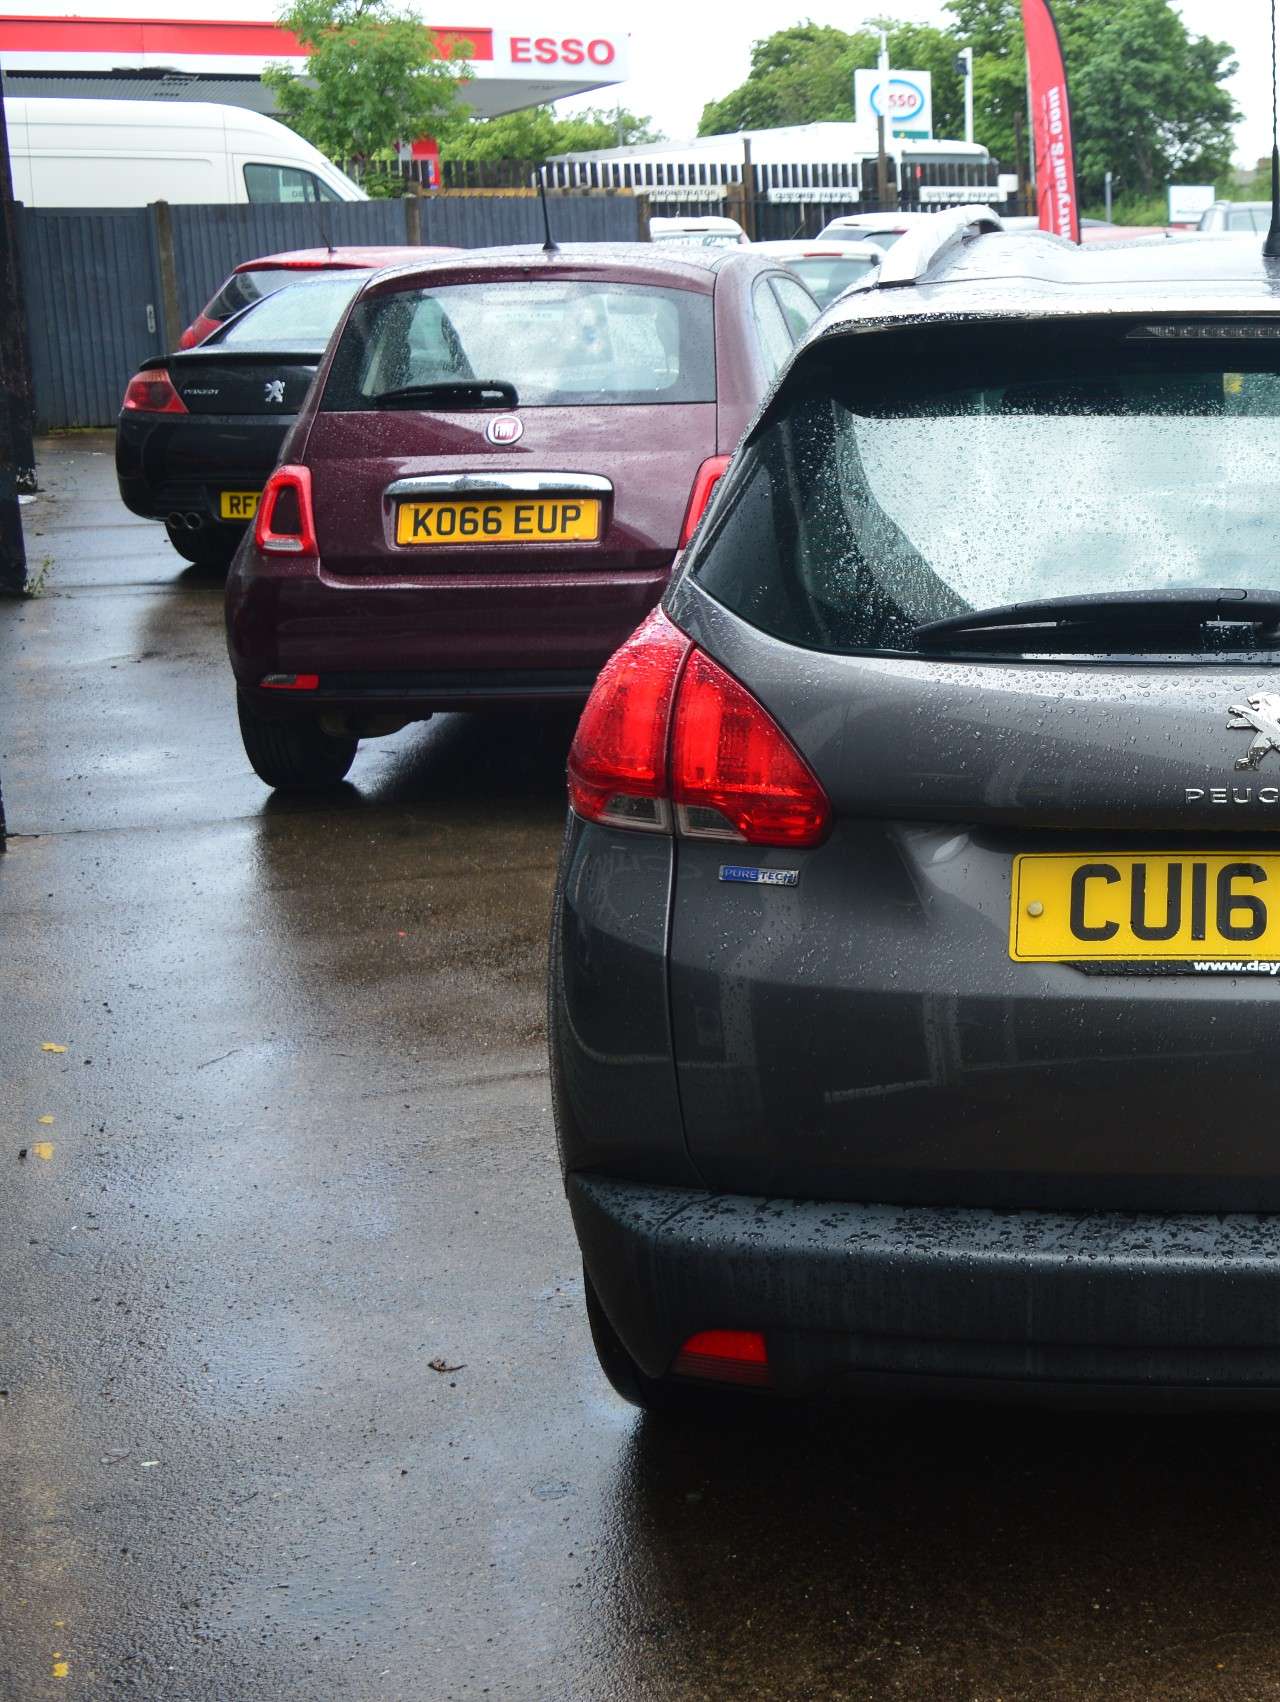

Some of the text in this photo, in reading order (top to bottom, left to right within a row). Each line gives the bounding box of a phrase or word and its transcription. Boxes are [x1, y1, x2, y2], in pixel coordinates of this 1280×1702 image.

[509, 37, 615, 65] ESSO
[882, 94, 917, 108] SSO
[229, 495, 261, 514] RF
[412, 504, 581, 537] KO66 EUP
[1069, 862, 1268, 942] CU16
